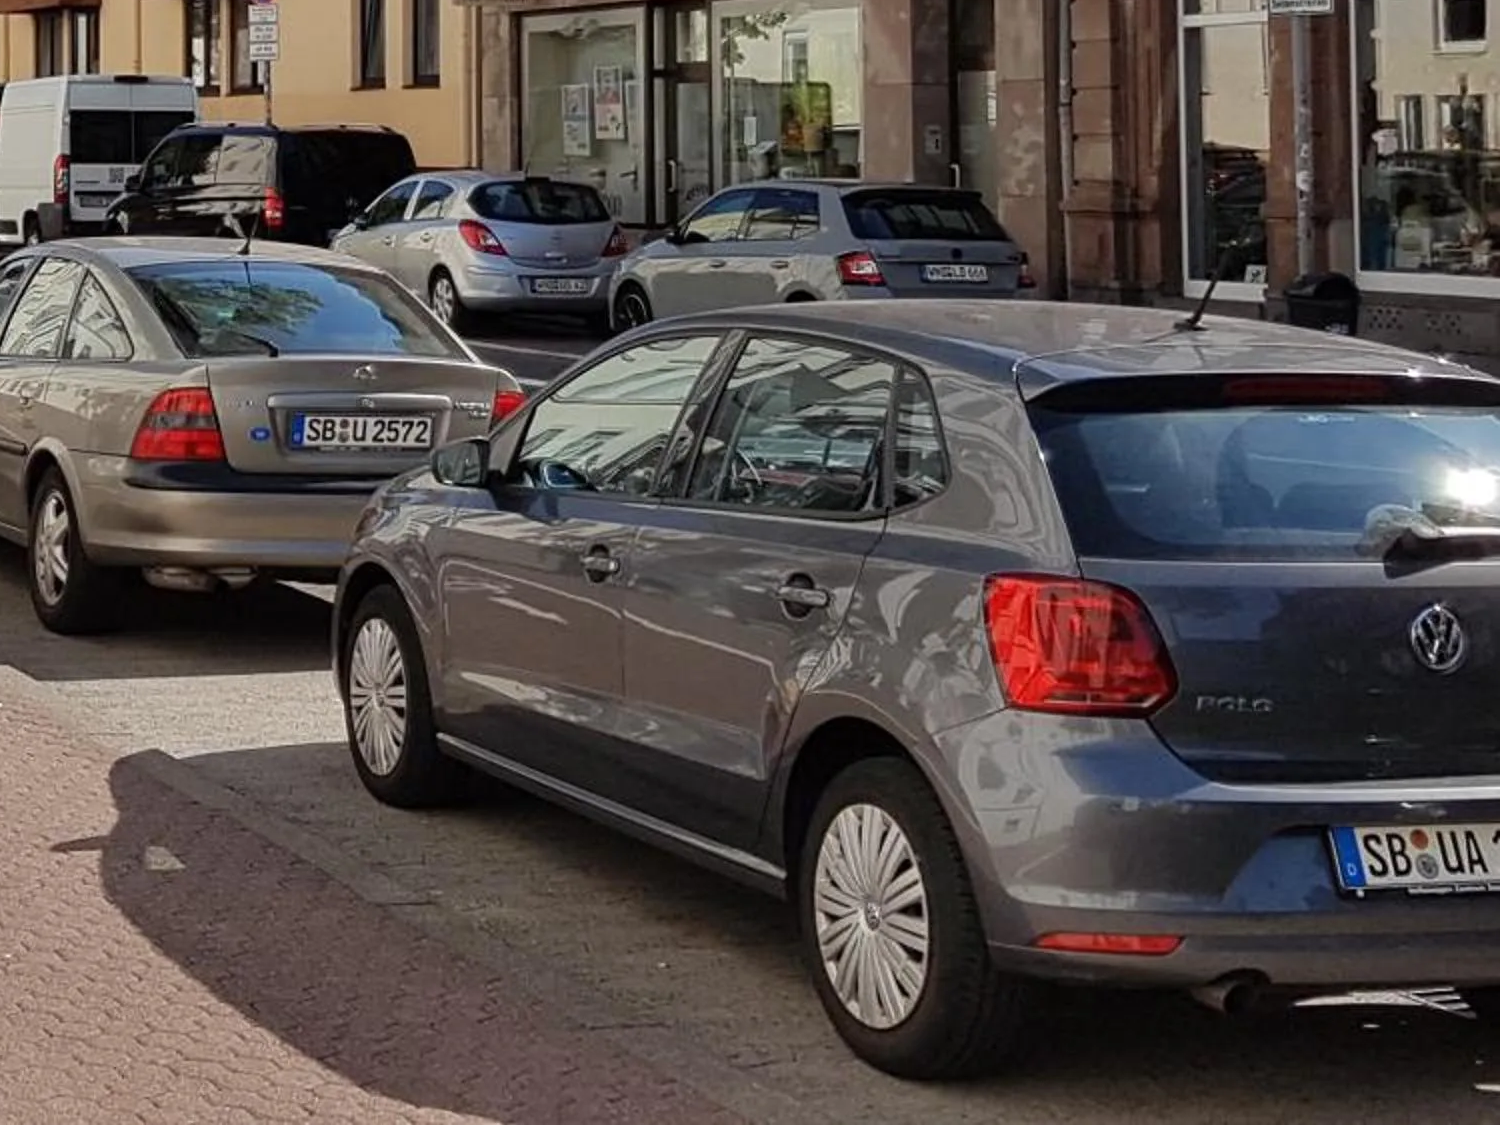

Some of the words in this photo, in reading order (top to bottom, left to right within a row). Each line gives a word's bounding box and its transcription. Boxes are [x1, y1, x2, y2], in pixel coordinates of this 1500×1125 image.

[306, 418, 336, 443] SB
[352, 419, 367, 443] U
[372, 419, 429, 444] 2572
[1195, 695, 1276, 713] POLO
[1362, 832, 1412, 878] SB
[1436, 829, 1489, 876] UA
